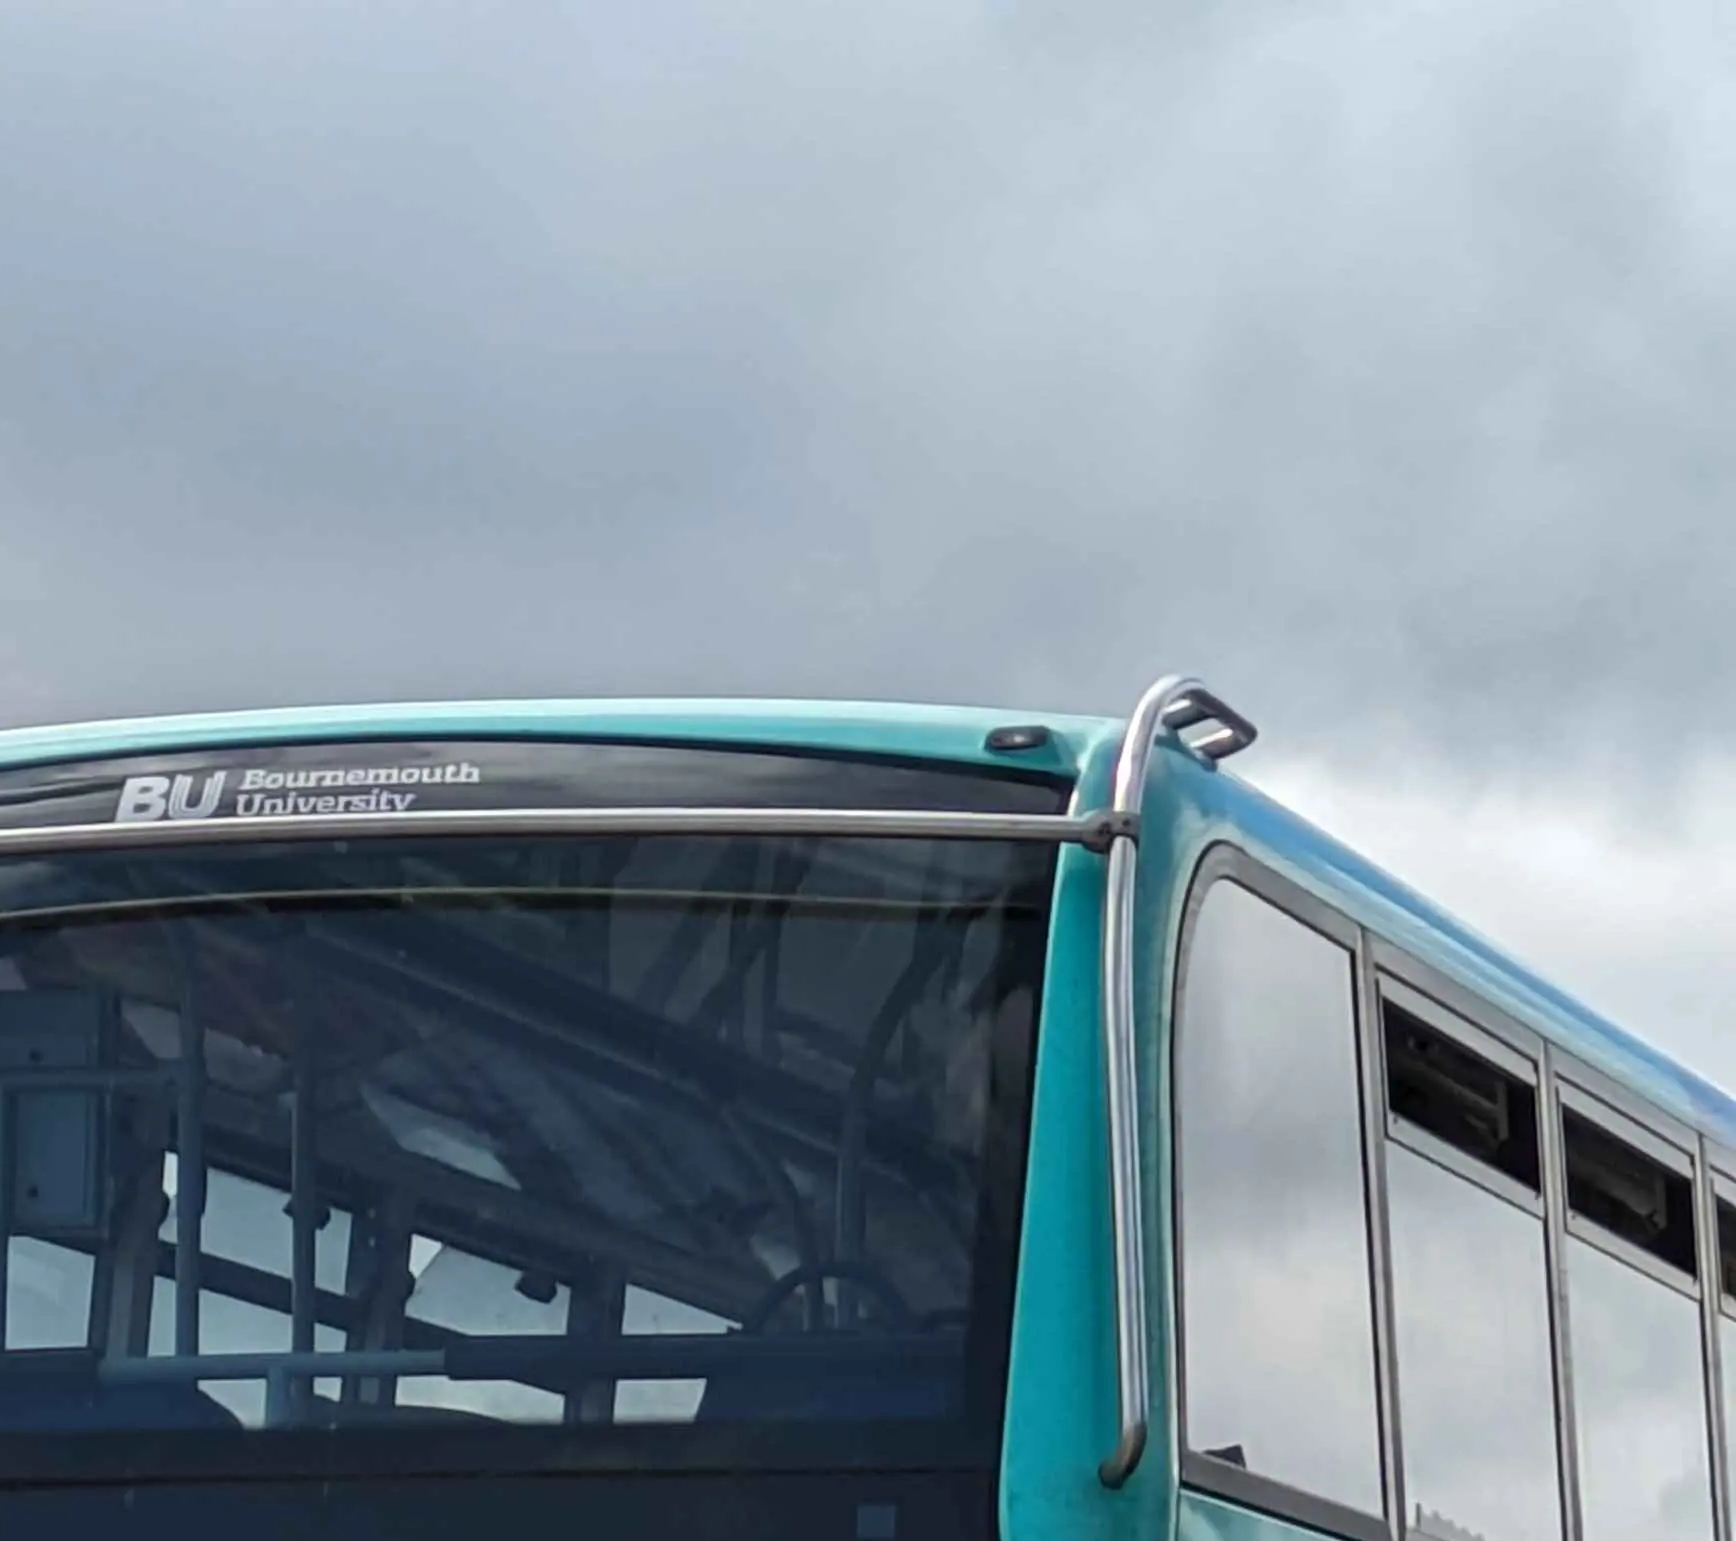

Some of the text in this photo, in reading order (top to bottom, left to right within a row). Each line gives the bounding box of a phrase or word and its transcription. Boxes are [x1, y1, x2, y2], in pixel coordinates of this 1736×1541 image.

[240, 762, 480, 790] Bournemouth
[115, 770, 226, 823] BU
[236, 788, 417, 817] University
